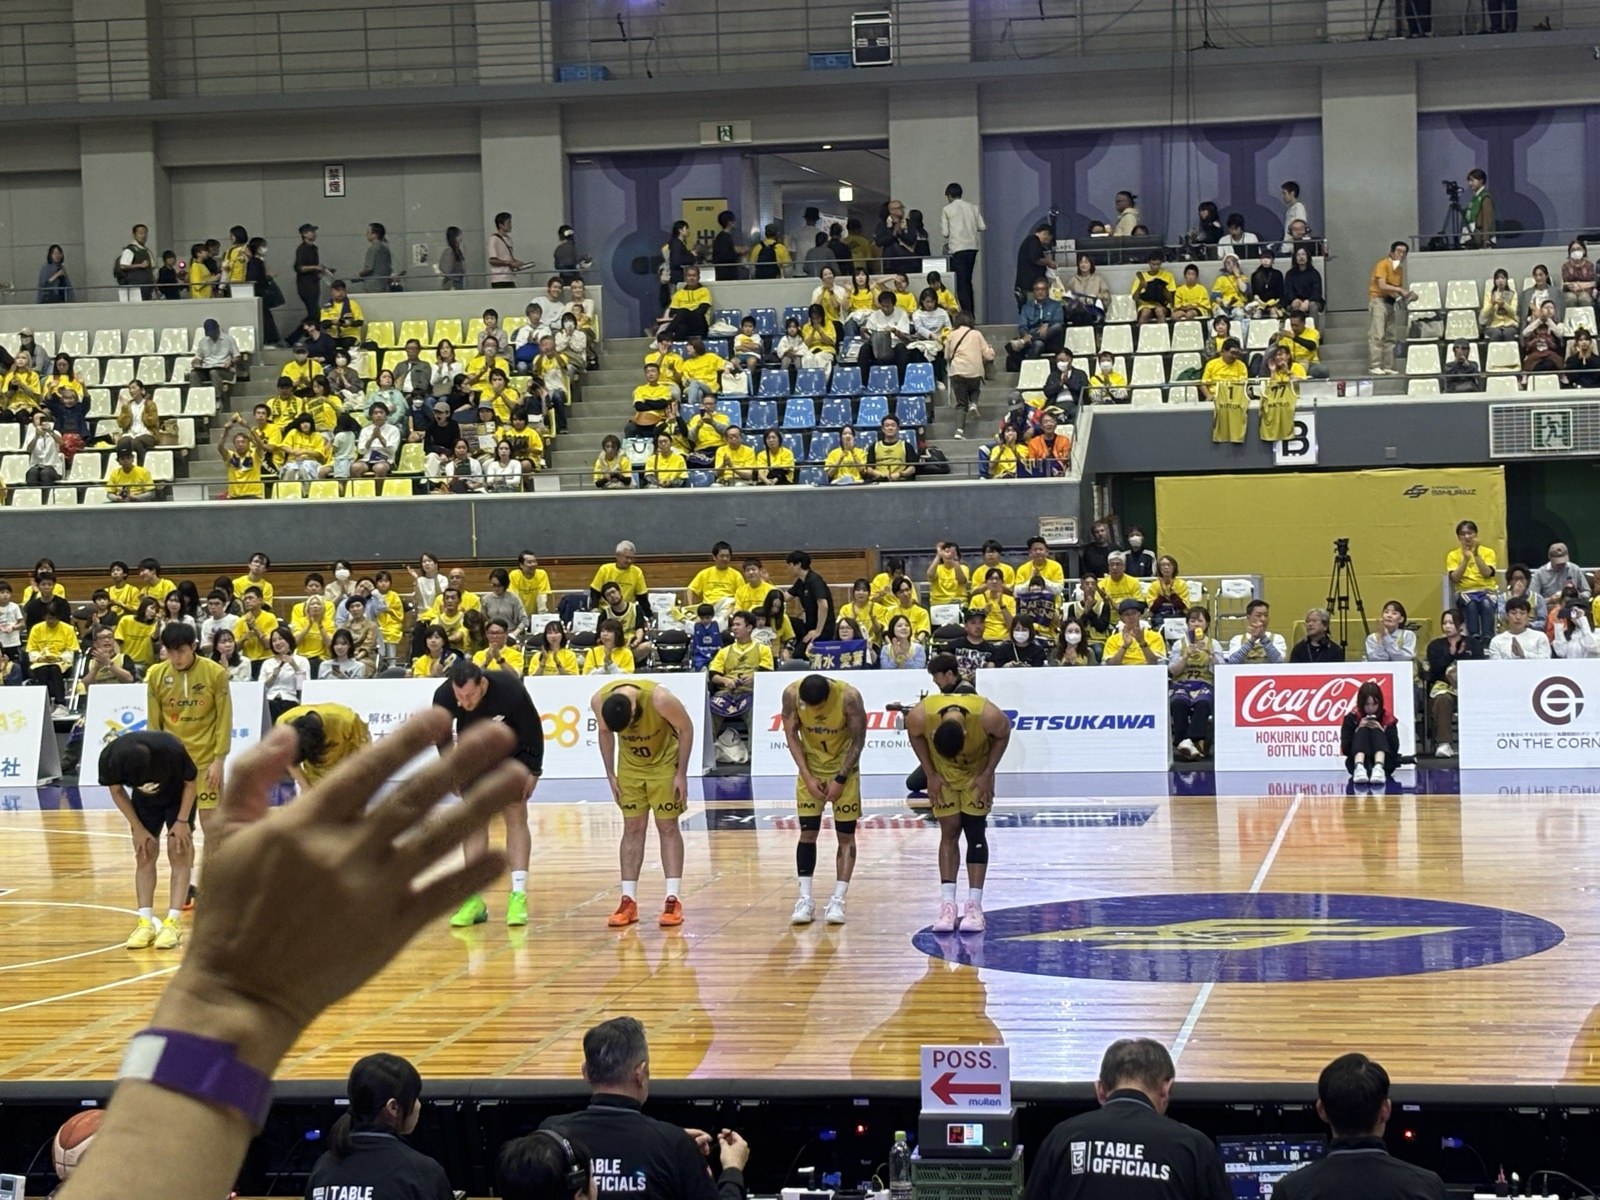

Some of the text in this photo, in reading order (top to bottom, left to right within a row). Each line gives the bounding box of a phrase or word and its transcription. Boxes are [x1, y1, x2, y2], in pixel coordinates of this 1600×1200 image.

[1271, 385, 1286, 399] 77
[1241, 677, 1387, 723] Coca-Col
[1256, 731, 1340, 743] HOKURIKU COCA
[1497, 738, 1519, 749] ON
[1523, 738, 1554, 749] THE
[631, 747, 651, 757] 20
[1267, 745, 1316, 757] BOTTLING
[933, 1050, 997, 1069] POSS.
[968, 1098, 1001, 1106] molten
[1094, 1141, 1144, 1159] TABLE
[1092, 1158, 1170, 1180] OFFICIALS
[593, 1176, 647, 1191] FICIALS
[330, 1186, 374, 1200] TABLE
